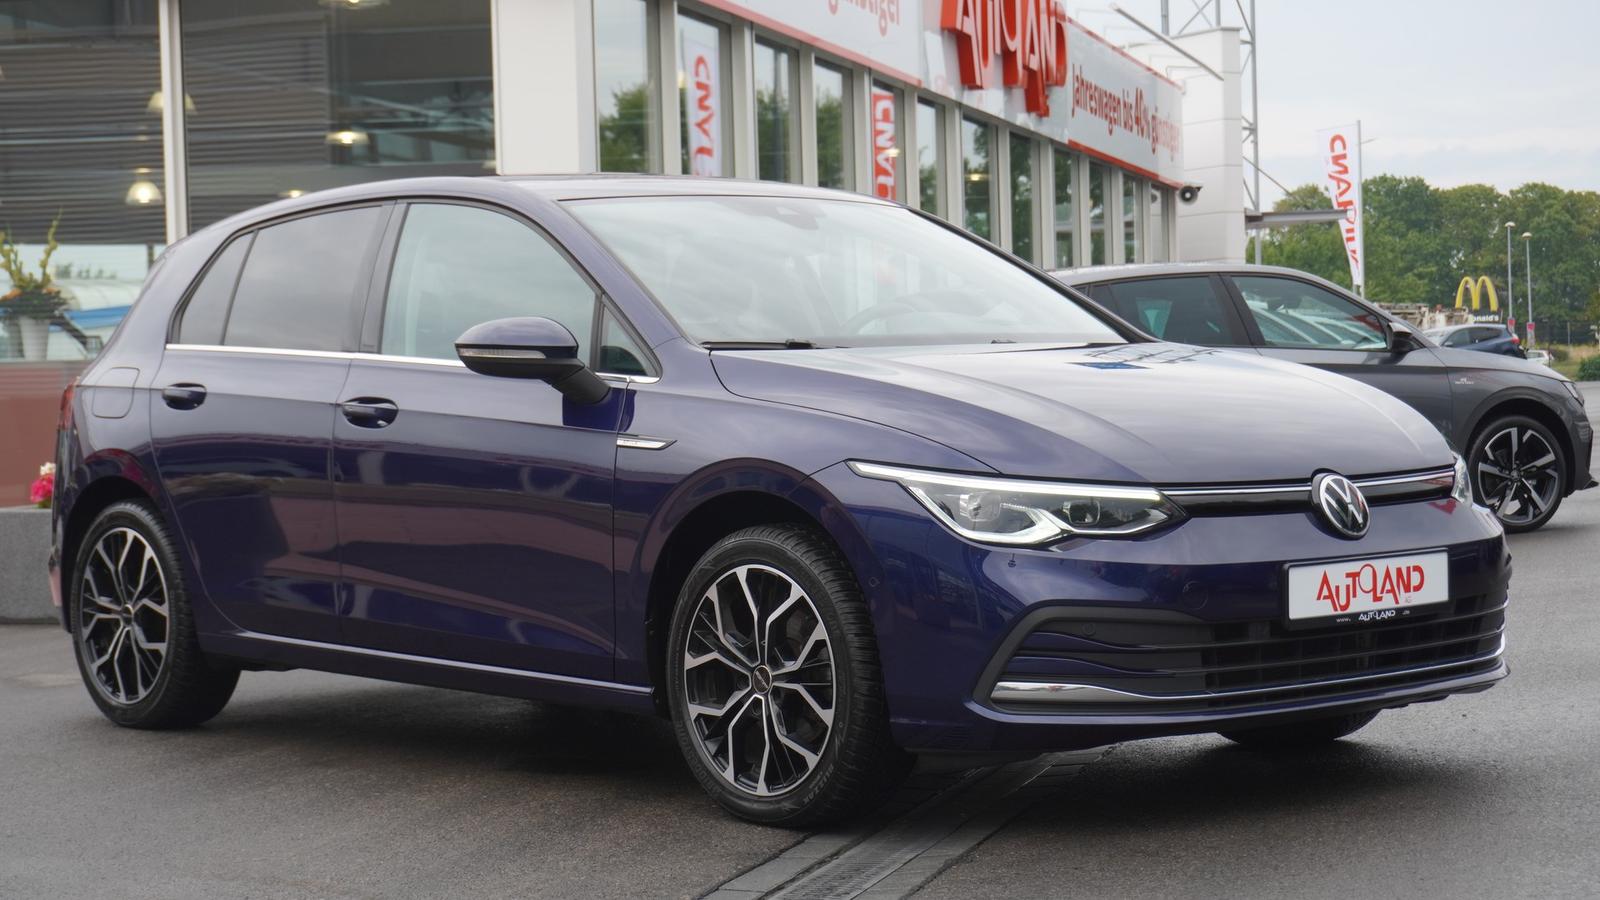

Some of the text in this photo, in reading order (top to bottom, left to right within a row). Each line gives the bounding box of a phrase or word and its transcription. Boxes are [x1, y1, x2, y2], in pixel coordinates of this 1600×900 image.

[1071, 63, 1122, 136] Jahreswagen
[1122, 87, 1133, 133] bis
[1316, 563, 1425, 612] AUTOLAND
[1358, 610, 1396, 621] AUTOLAND
